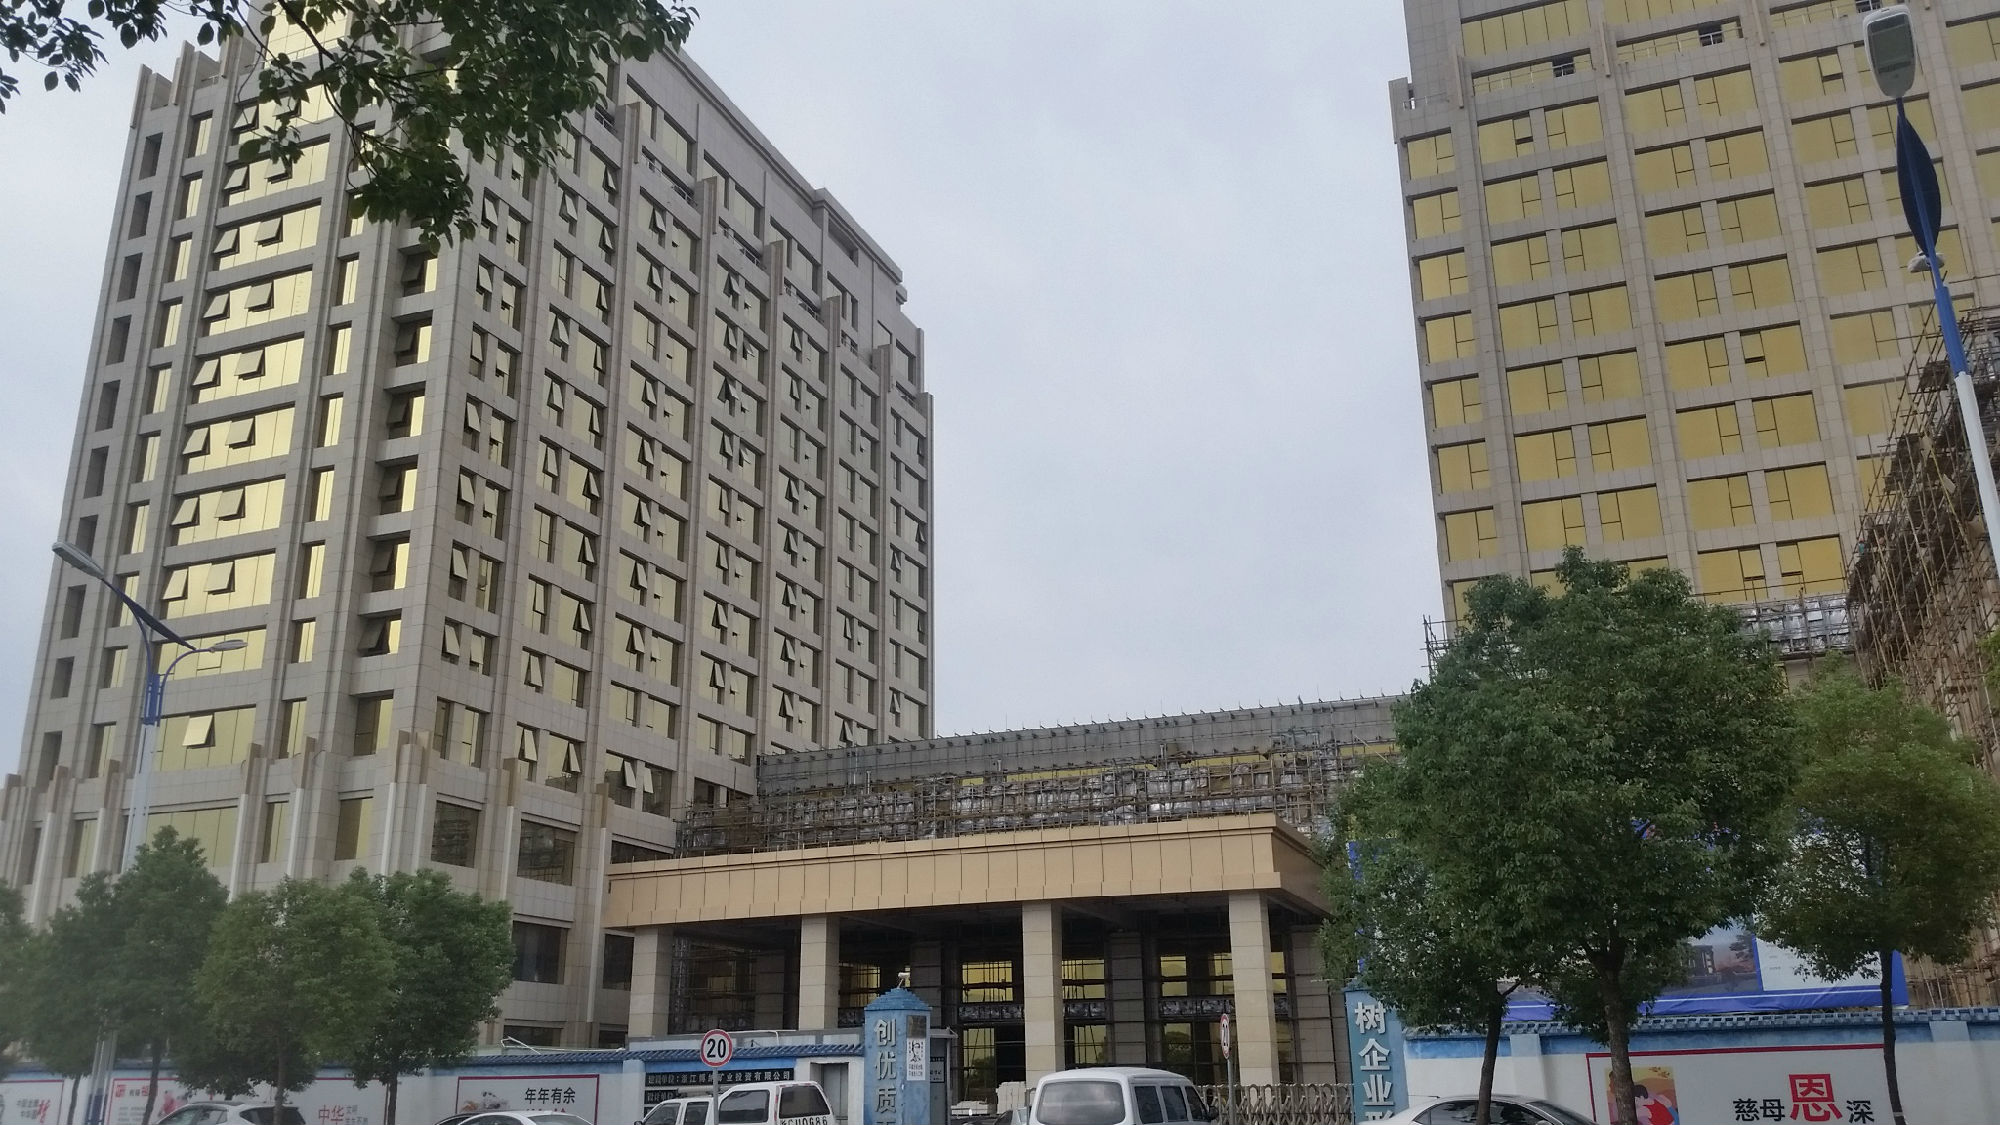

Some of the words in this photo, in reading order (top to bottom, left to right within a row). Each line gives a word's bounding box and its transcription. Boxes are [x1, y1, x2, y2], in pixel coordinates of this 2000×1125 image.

[707, 1038, 726, 1058] 20
[874, 1018, 897, 1125] 创优质
[524, 1087, 576, 1104] 年年有余
[1733, 1073, 1875, 1124] 慈母恩深
